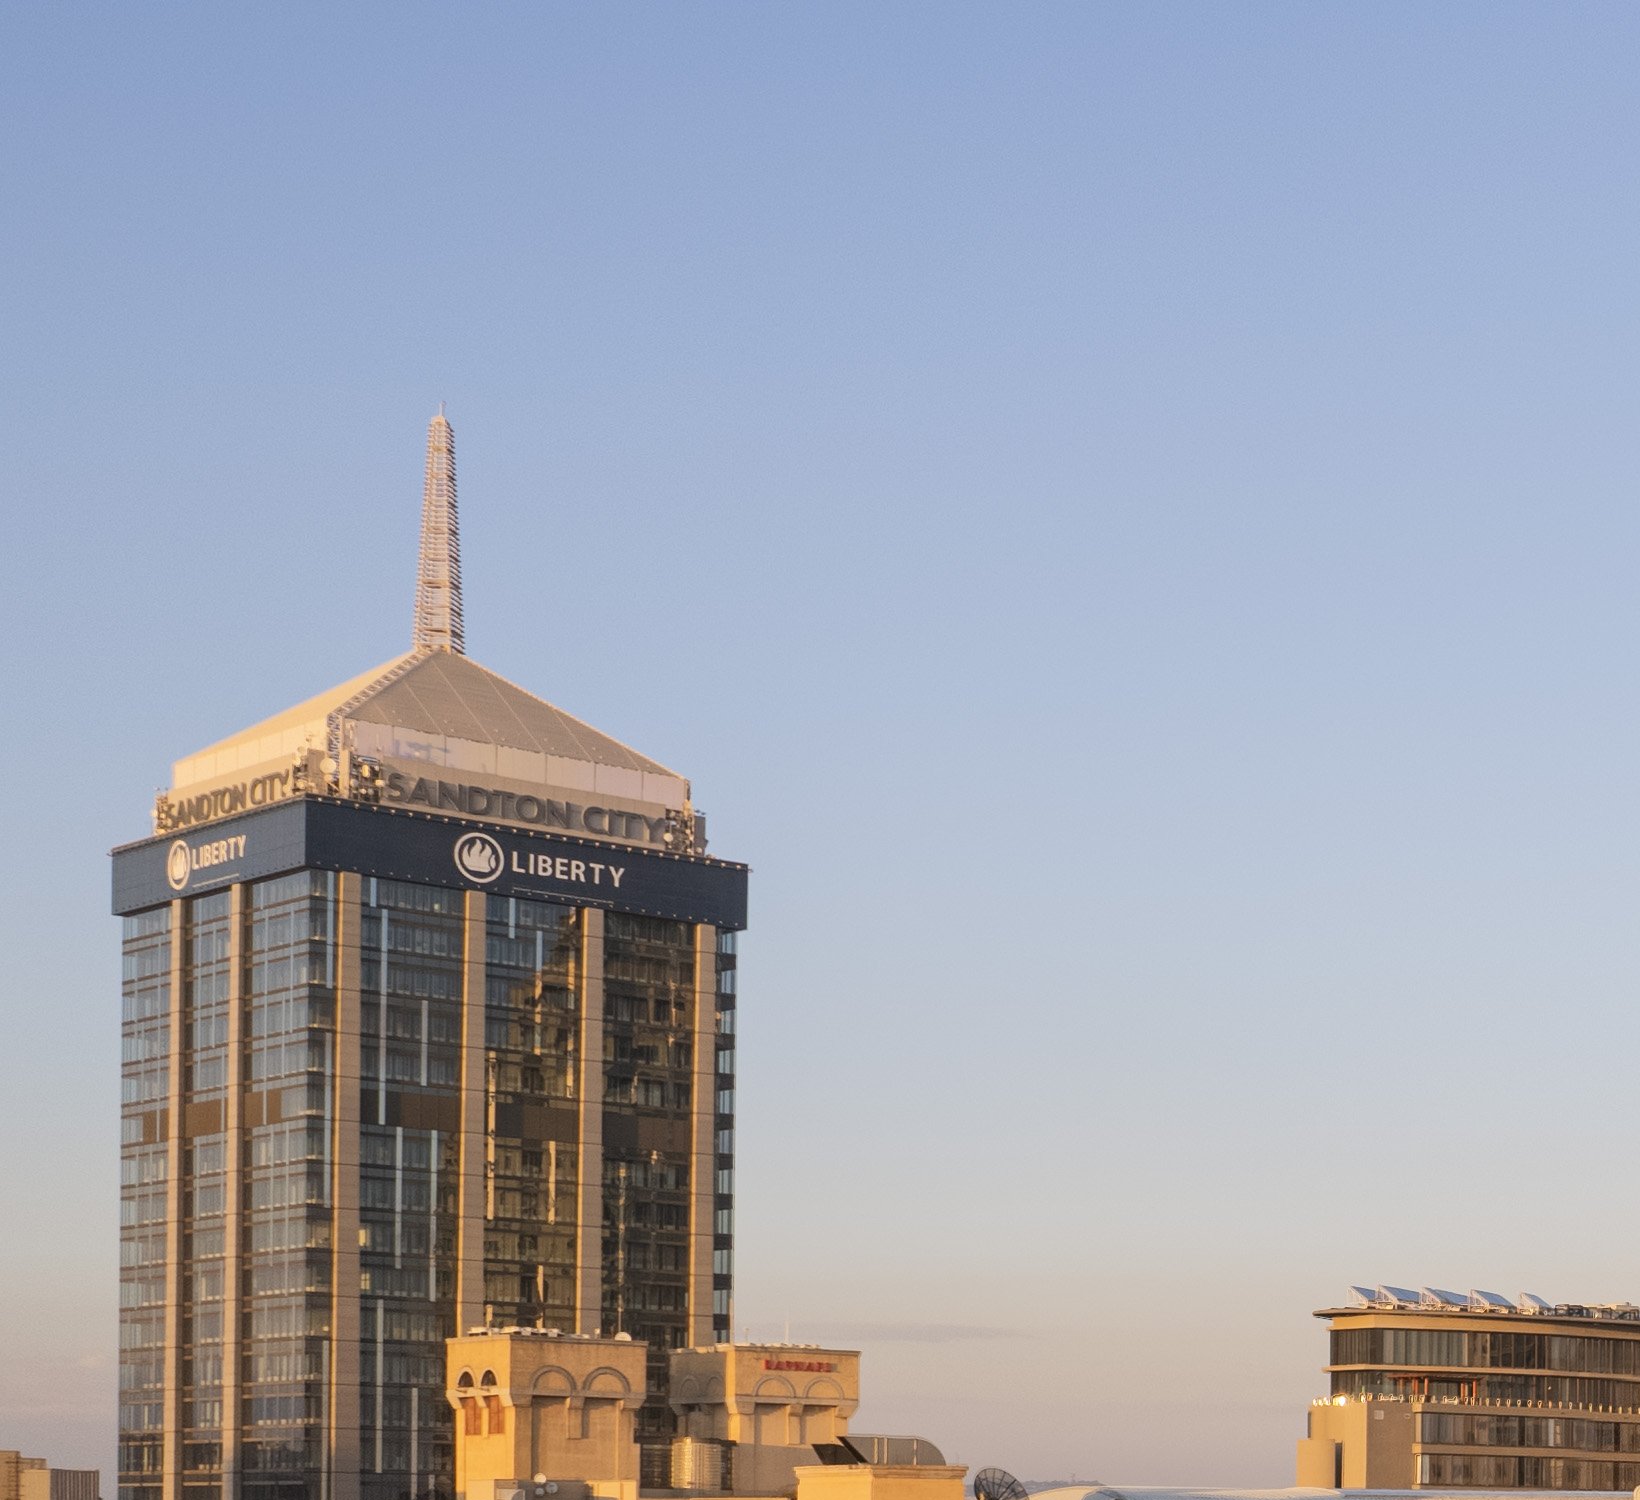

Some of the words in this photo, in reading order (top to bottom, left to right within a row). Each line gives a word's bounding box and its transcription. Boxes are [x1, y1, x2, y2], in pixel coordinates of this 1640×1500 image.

[166, 783, 247, 830] SANDTON
[250, 768, 290, 805] CITY
[385, 772, 571, 829] SANDTON
[582, 805, 667, 845] CITY
[191, 834, 247, 870] LIBERTY
[511, 850, 625, 888] LIBERTY
